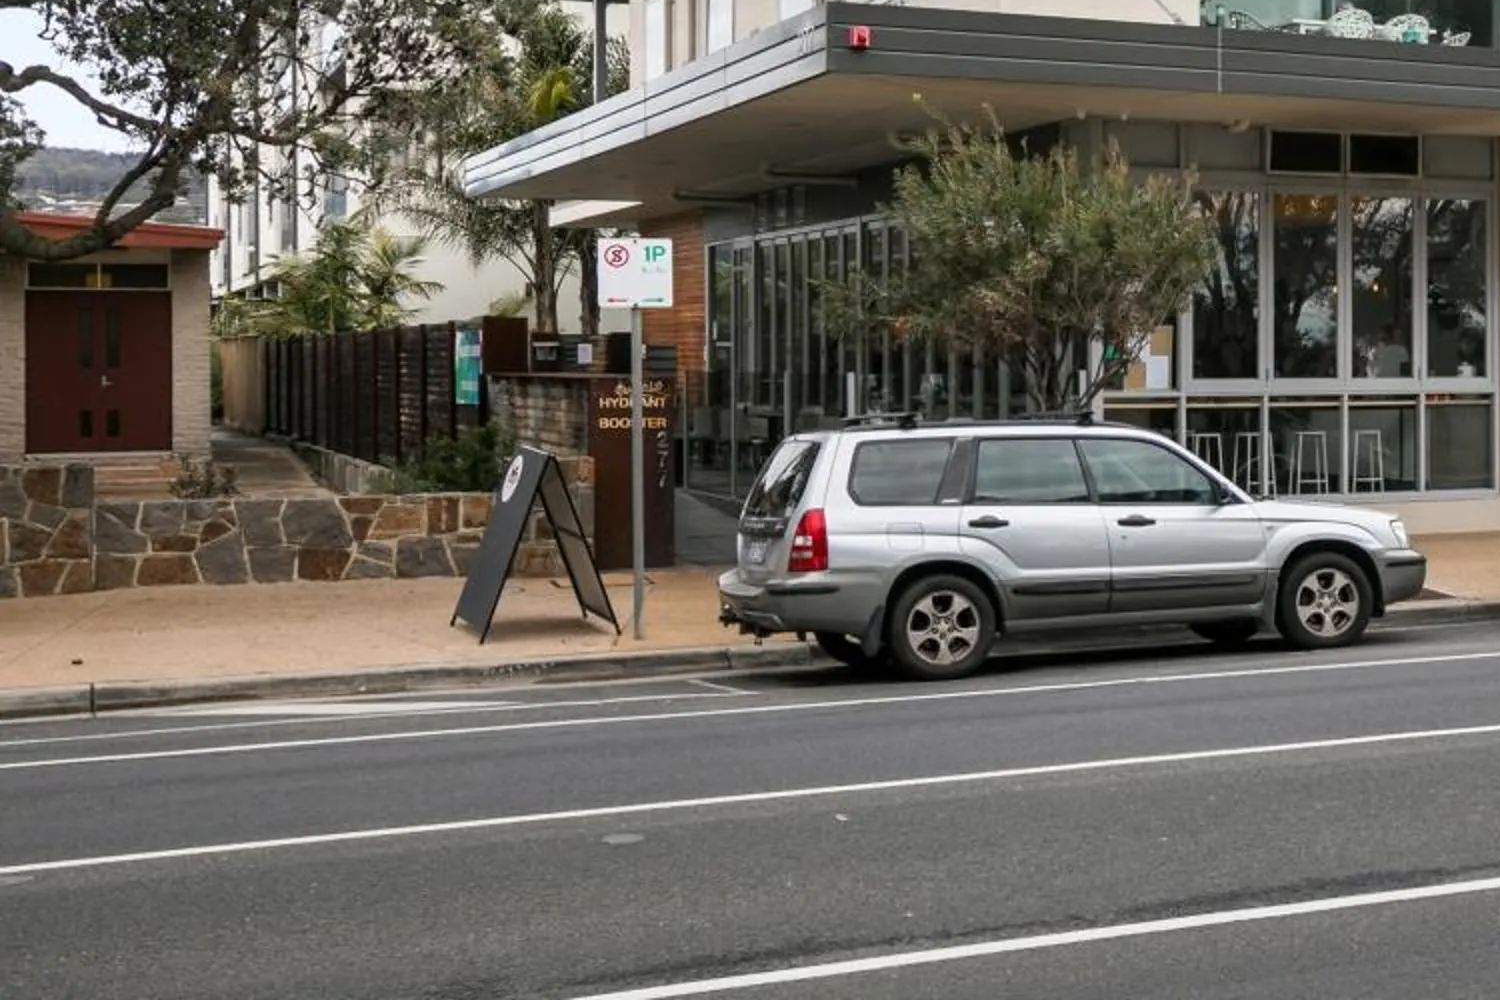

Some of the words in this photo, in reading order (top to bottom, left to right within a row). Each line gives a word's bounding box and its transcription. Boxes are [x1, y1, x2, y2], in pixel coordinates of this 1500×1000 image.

[644, 245, 666, 262] 1P
[599, 397, 666, 409] HYDANT
[599, 417, 667, 430] BOOTER
